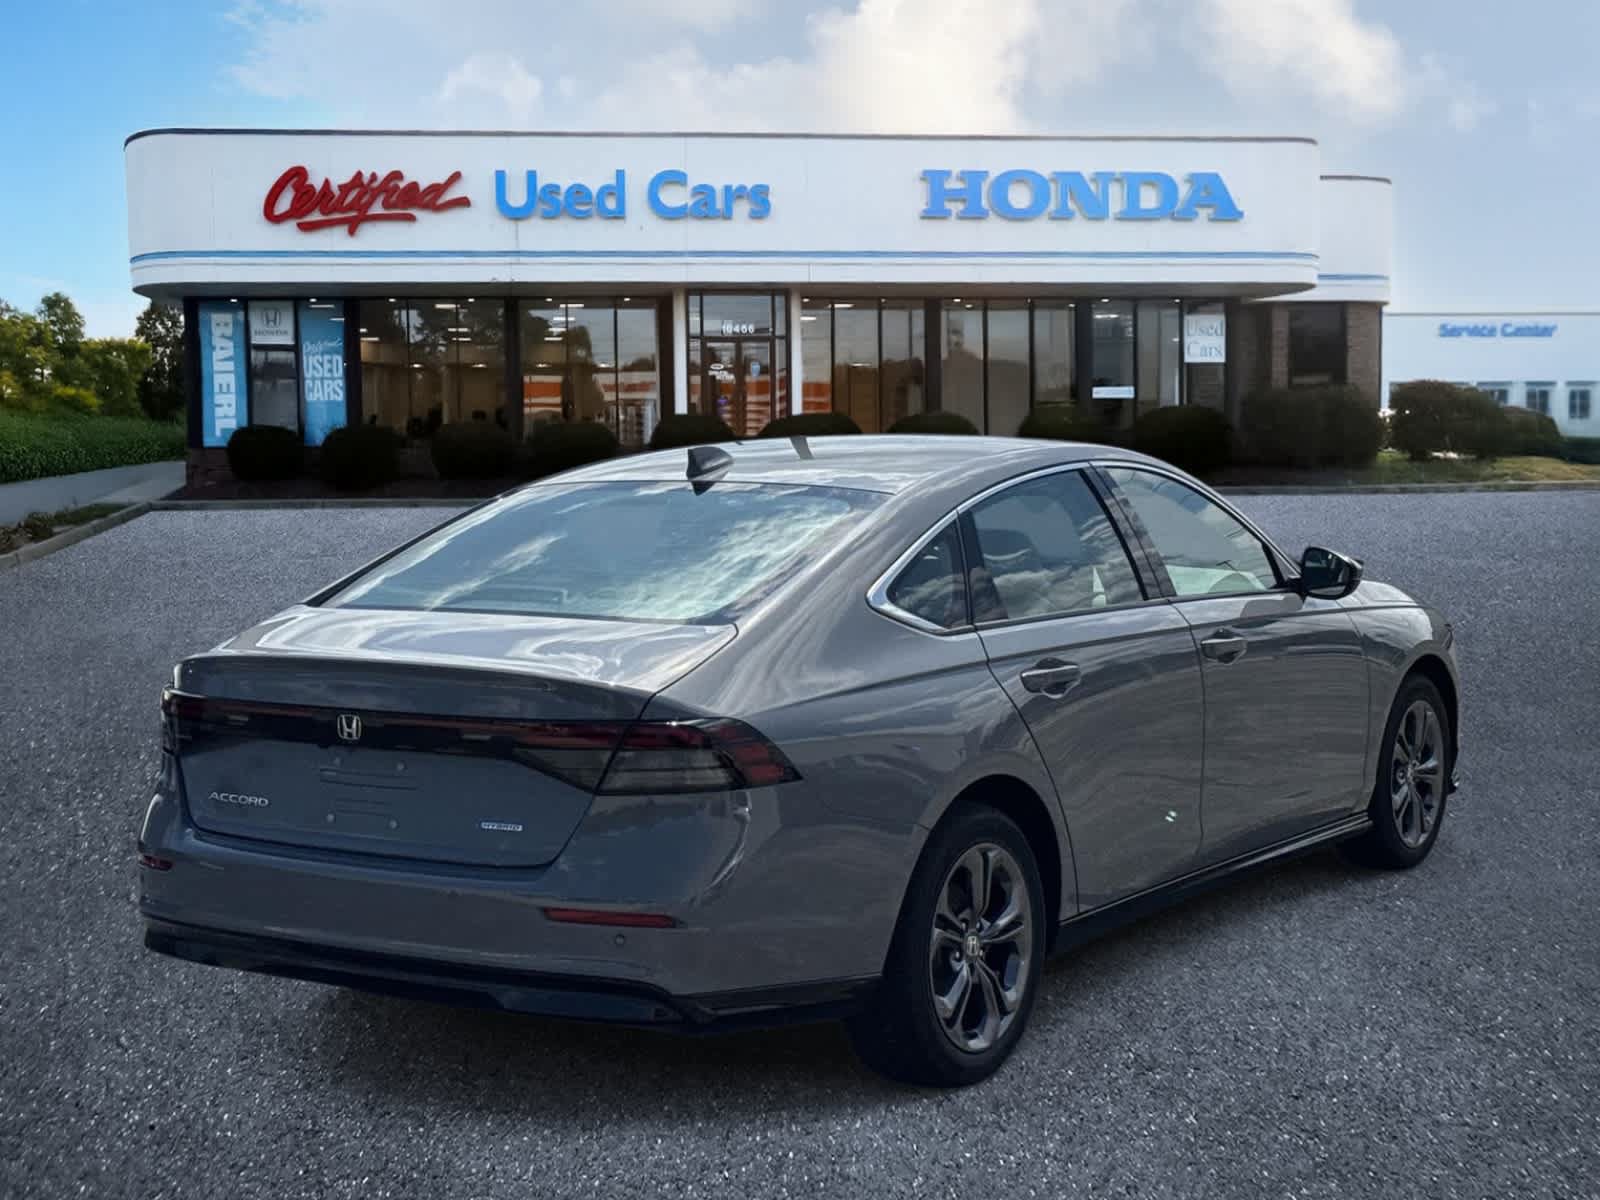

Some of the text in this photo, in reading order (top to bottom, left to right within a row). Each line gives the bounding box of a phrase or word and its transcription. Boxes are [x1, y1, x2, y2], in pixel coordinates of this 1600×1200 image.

[263, 165, 771, 236] Certified Used Cars
[919, 169, 1245, 222] HONDA
[1187, 319, 1224, 337] Used
[1438, 323, 1557, 338] Service Center
[1187, 342, 1224, 358] Cars
[210, 312, 237, 437] BAIERL
[303, 354, 343, 378] USED
[304, 379, 344, 401] CARS
[208, 791, 269, 807] ACCORD
